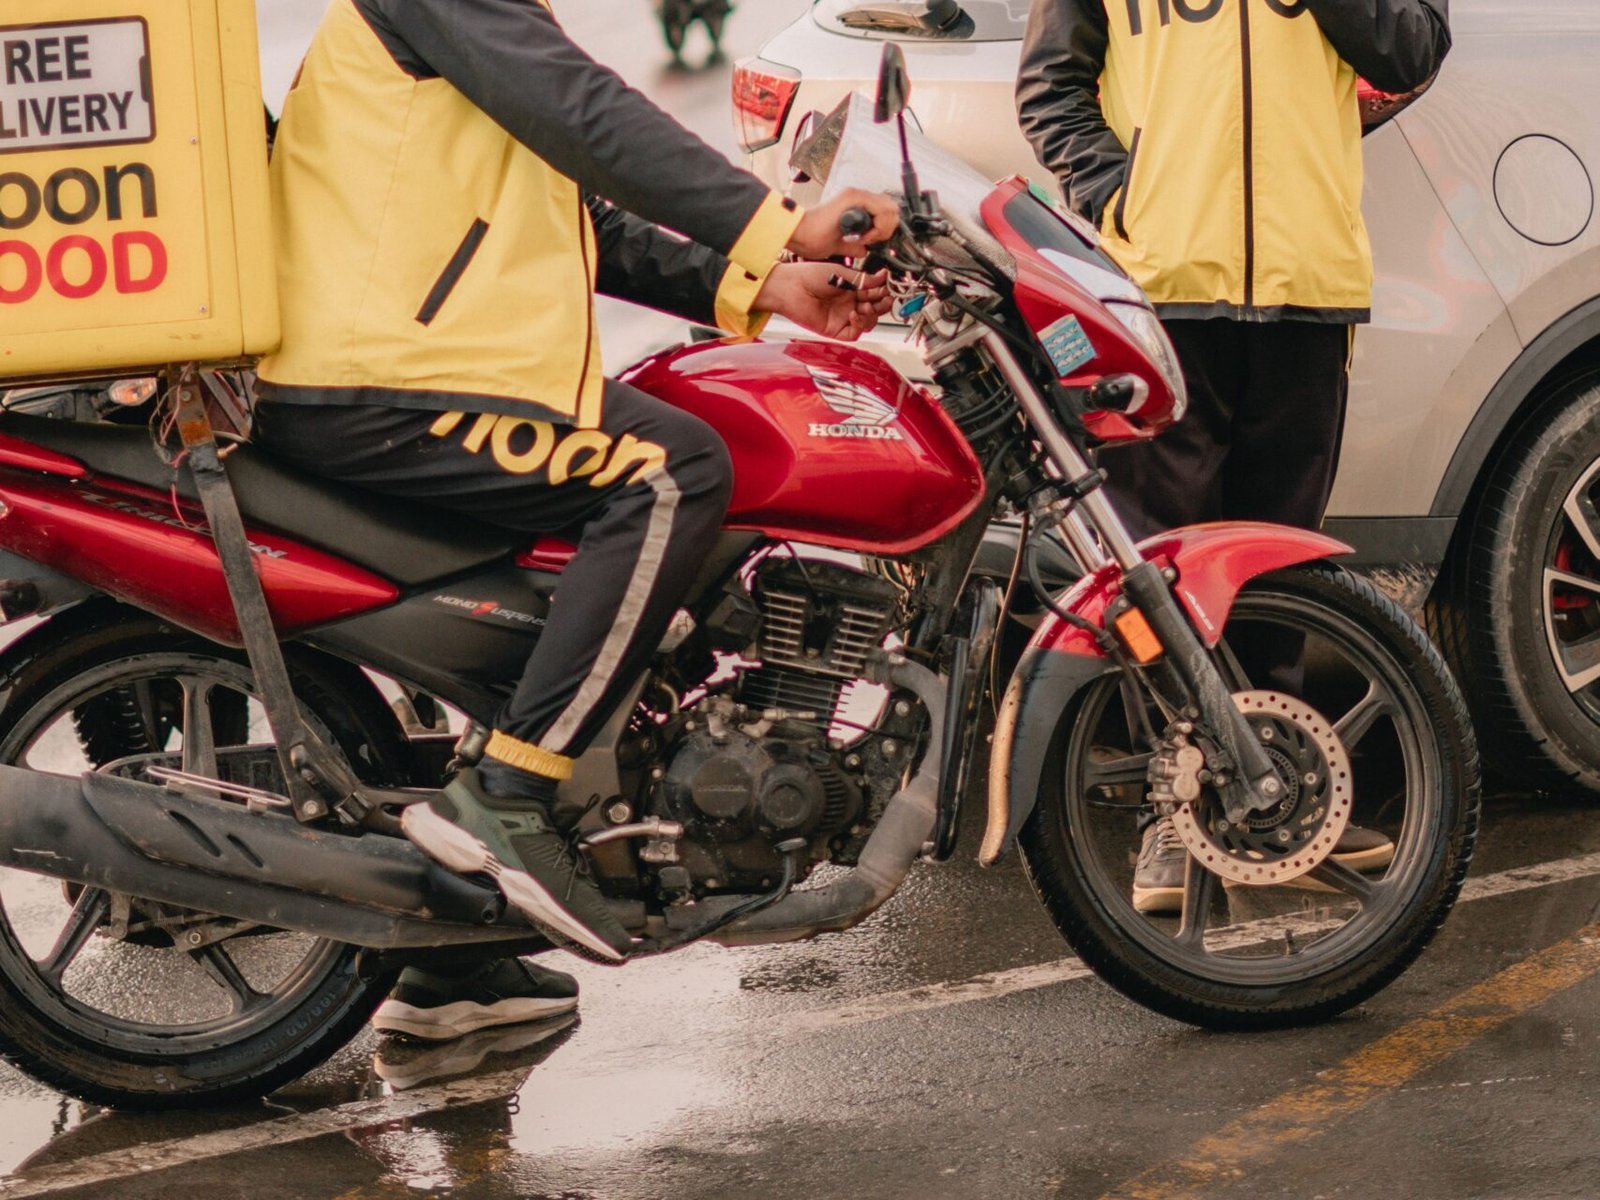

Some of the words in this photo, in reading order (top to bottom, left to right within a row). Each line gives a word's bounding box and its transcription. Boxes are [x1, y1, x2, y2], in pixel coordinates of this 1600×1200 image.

[4, 35, 92, 85] REE
[0, 91, 134, 139] LIVERY
[0, 162, 158, 230] oon
[0, 231, 168, 304] OOD
[807, 423, 904, 440] HONDA
